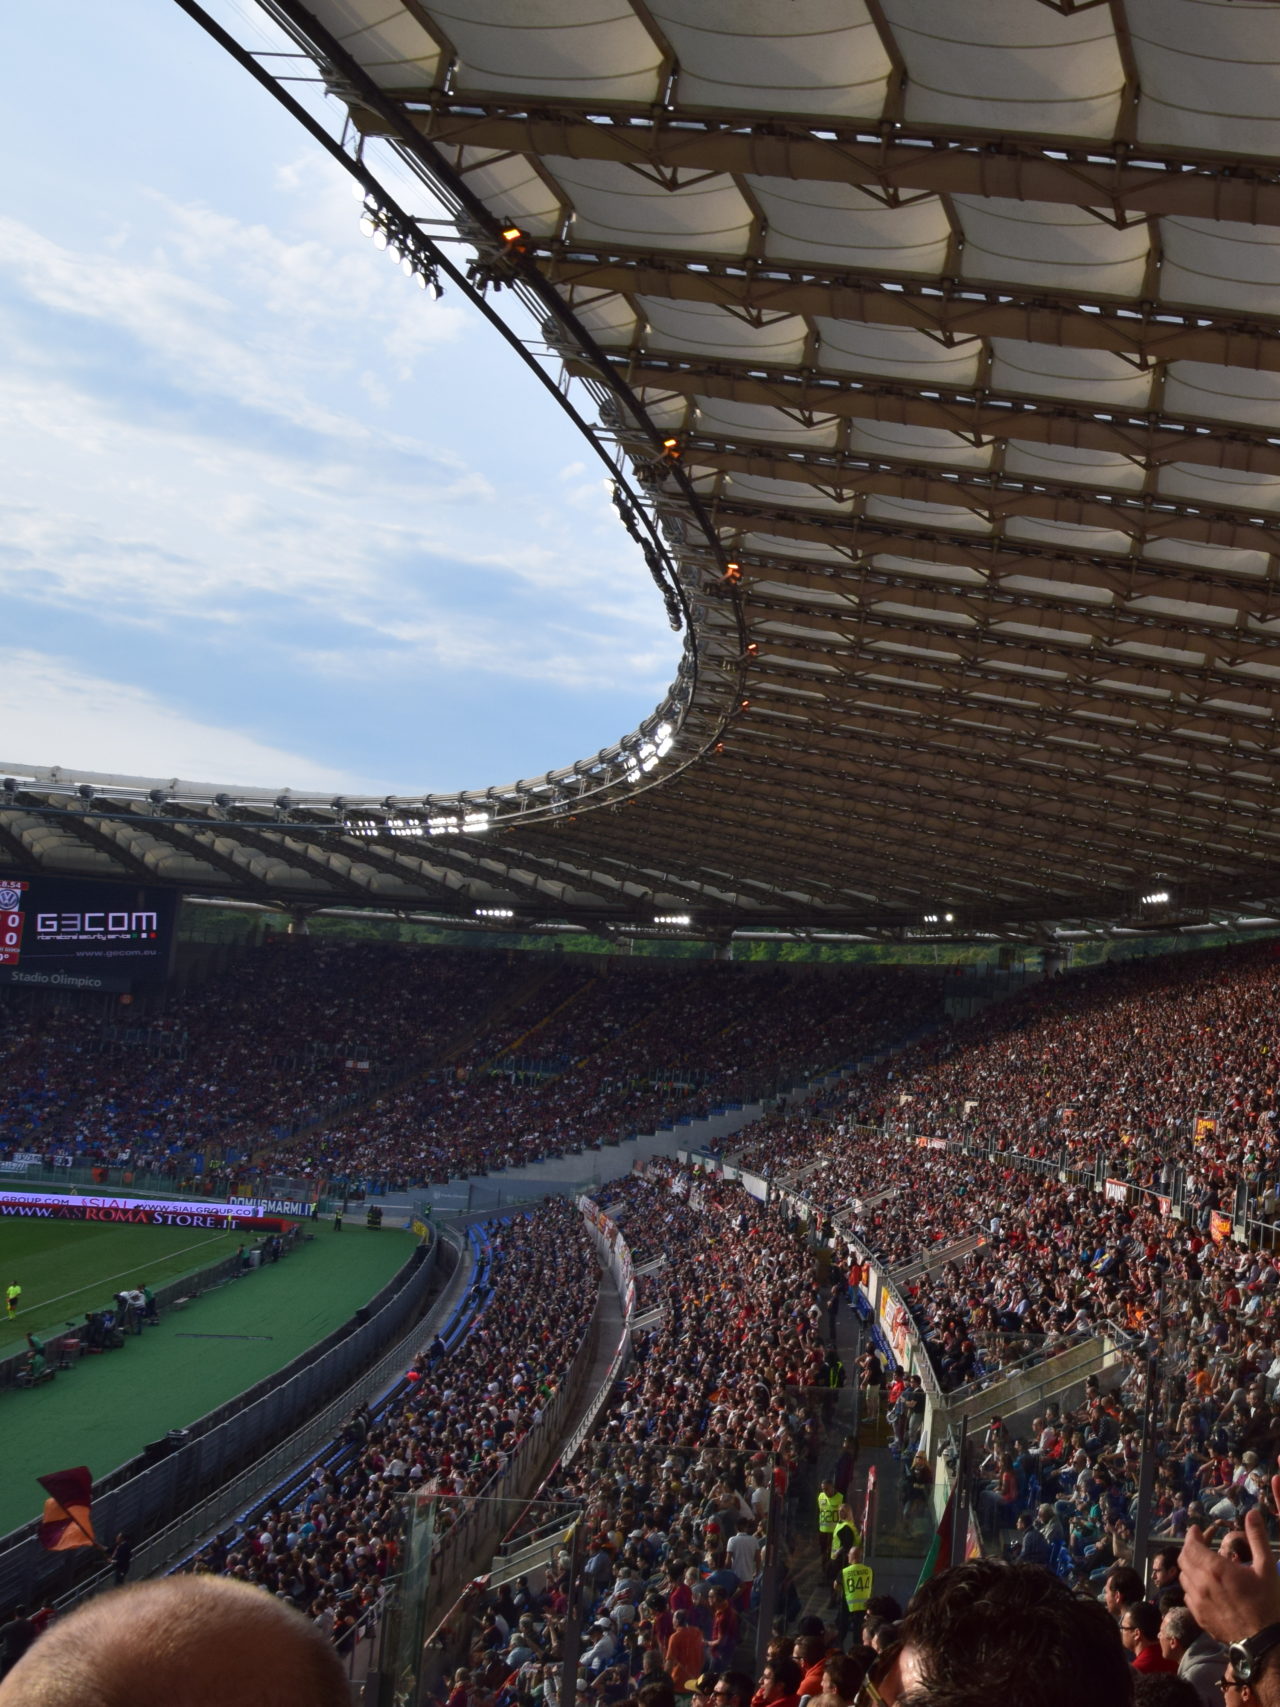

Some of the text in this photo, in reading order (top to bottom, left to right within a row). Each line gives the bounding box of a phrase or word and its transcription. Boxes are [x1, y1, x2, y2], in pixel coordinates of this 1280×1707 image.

[8, 914, 20, 927] 0
[5, 932, 17, 945] 0
[76, 950, 157, 958] www.gecom.eu
[11, 971, 102, 987] Stadio Olimpico
[847, 1577, 870, 1592] 844
